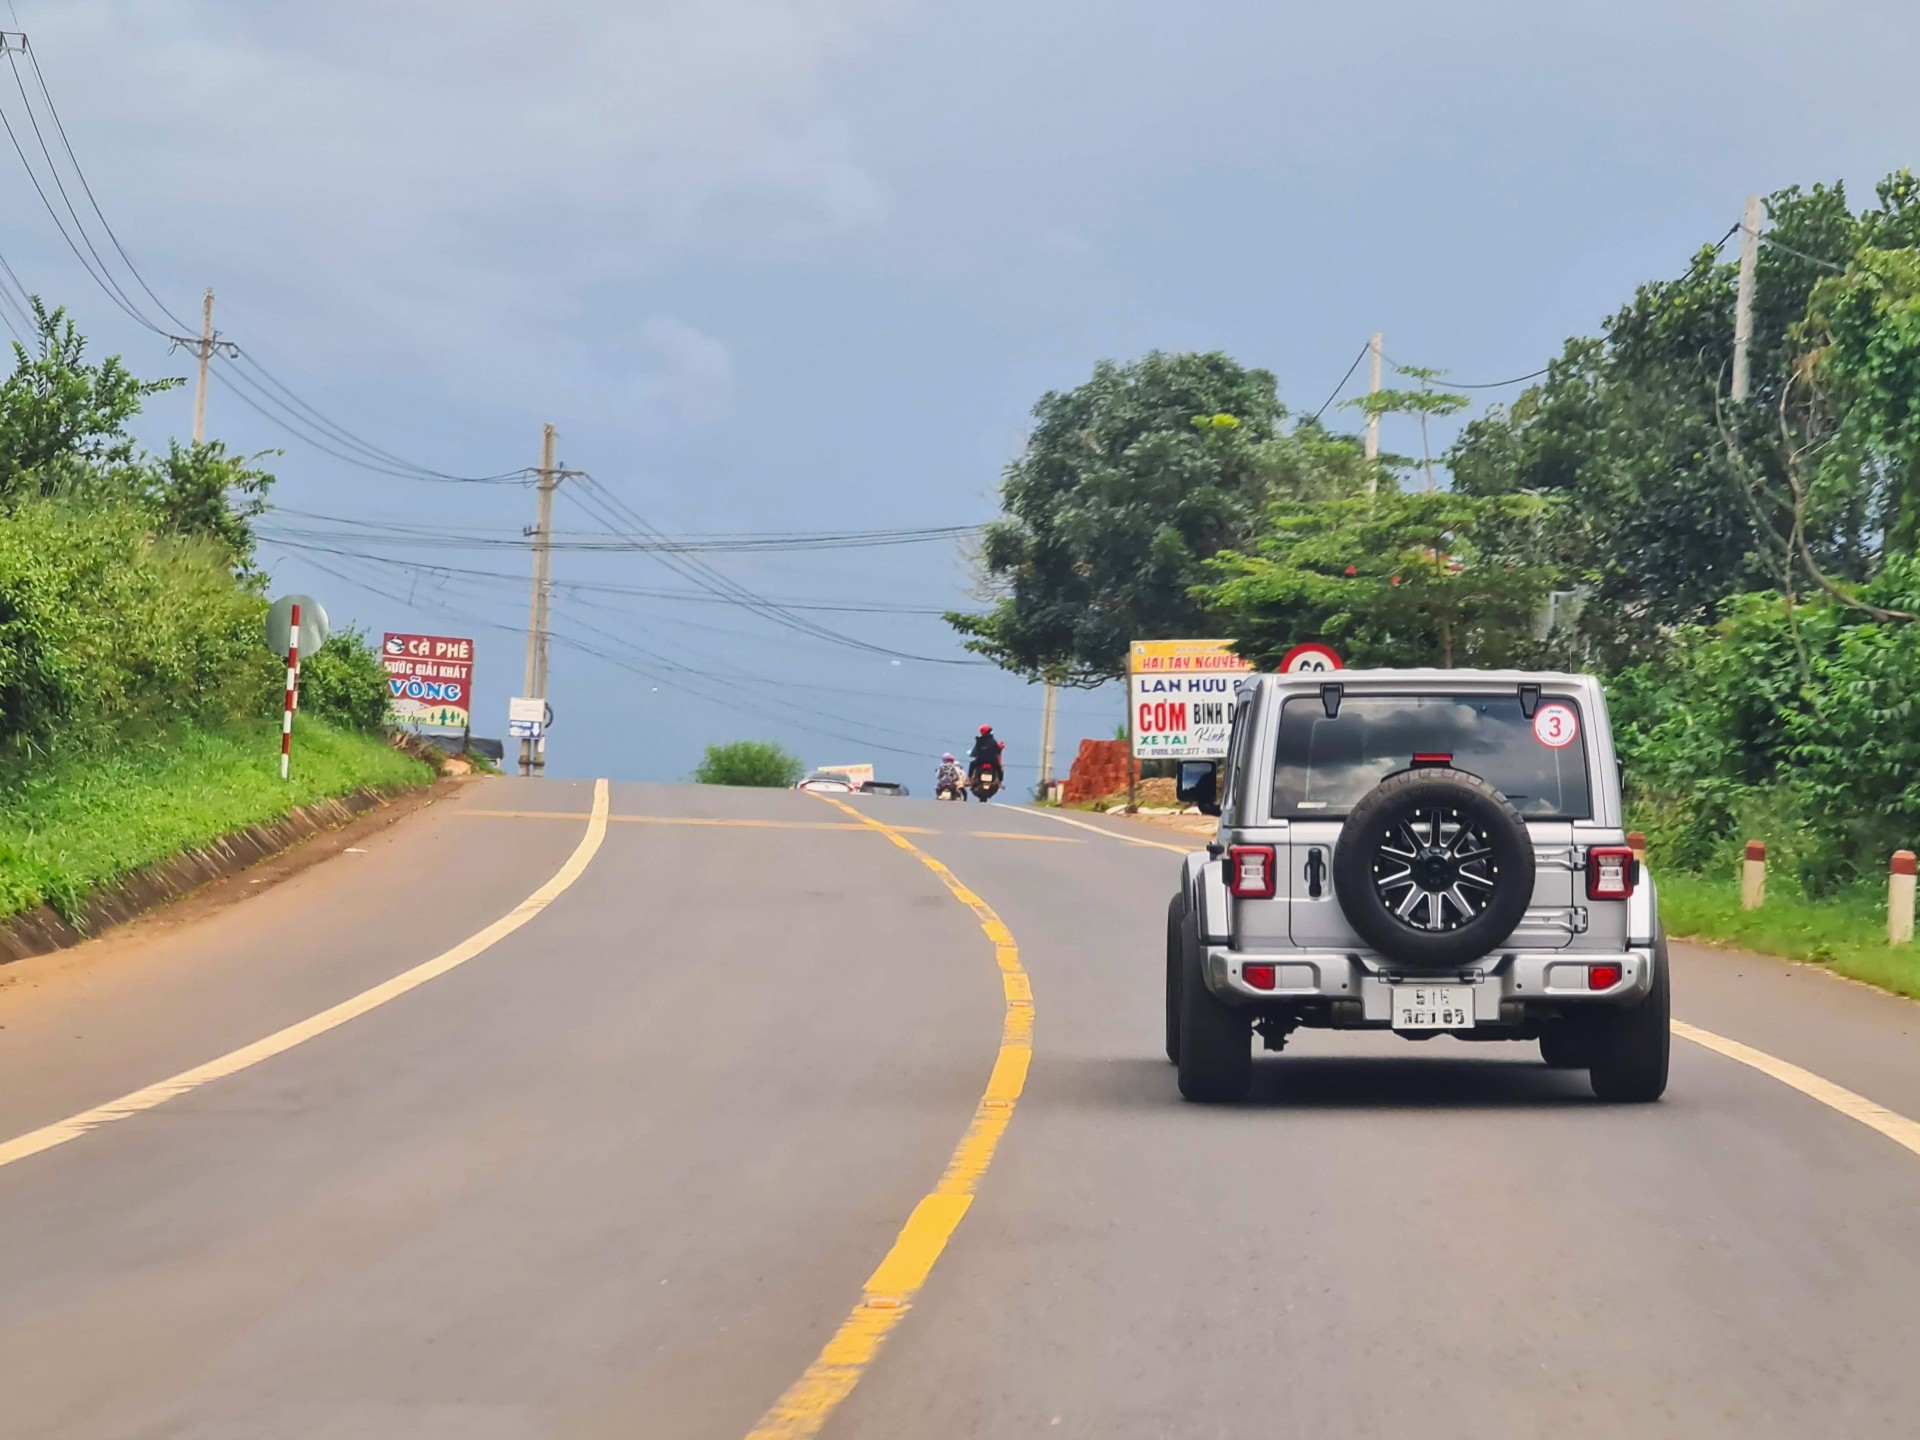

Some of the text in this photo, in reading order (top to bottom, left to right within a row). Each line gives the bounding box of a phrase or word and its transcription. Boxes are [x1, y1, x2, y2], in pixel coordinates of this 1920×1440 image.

[435, 640, 470, 659] PHÊ
[415, 661, 438, 677] GIẢI
[439, 664, 468, 679] KHÁT
[388, 676, 462, 701] VÕNG
[1141, 679, 1182, 693] LAN
[1139, 699, 1187, 732] CƠM
[1549, 716, 1561, 737] 3
[1140, 735, 1159, 746] XE
